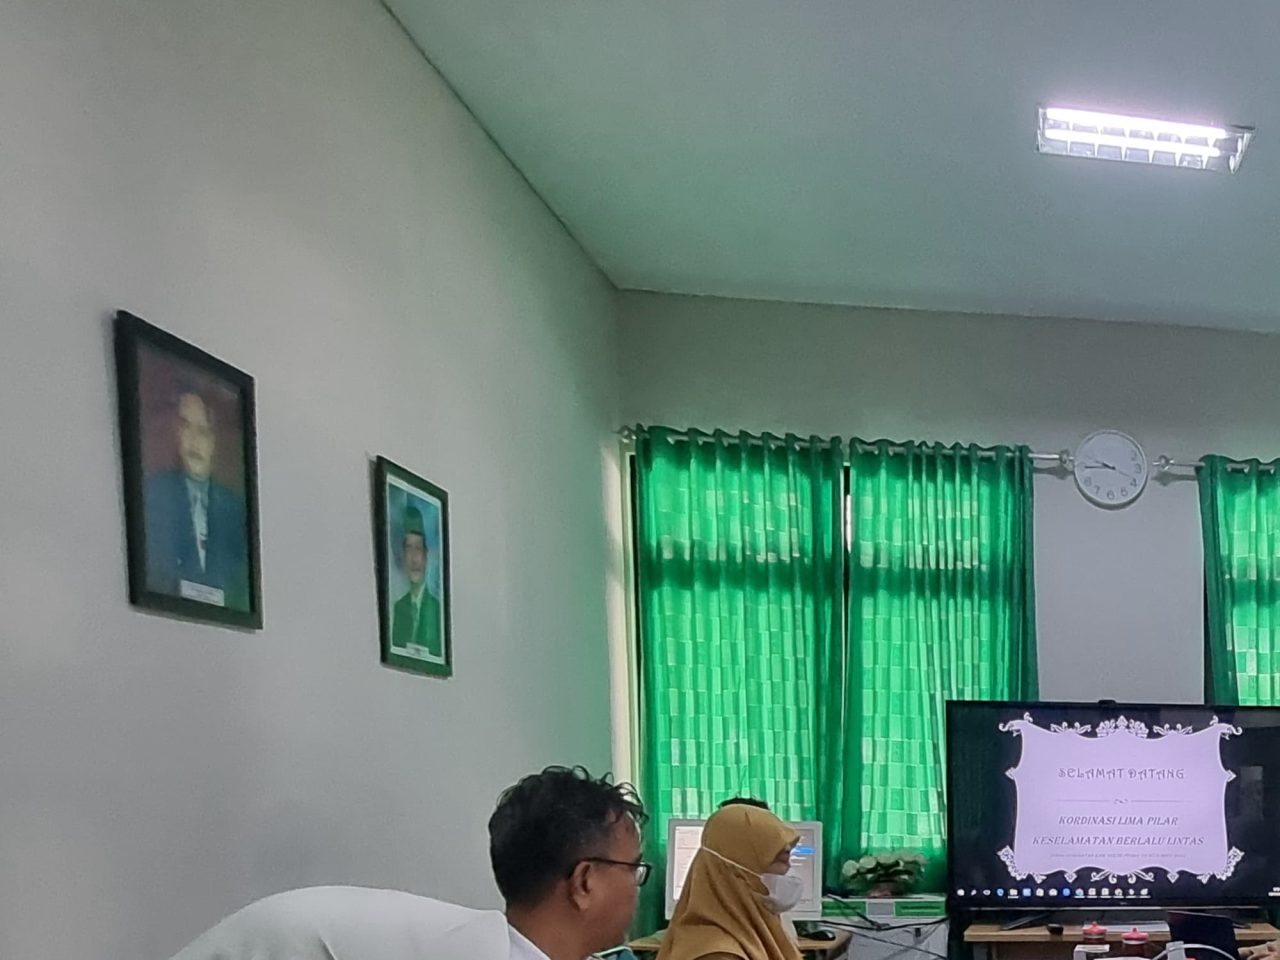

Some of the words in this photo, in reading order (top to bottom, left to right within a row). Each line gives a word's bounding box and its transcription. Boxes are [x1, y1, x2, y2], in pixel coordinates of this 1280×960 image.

[1058, 767, 1124, 780] SELAMAT
[1127, 768, 1185, 781] DATANG
[1058, 815, 1116, 826] KORDINASI
[1117, 816, 1144, 826] LIMA
[1146, 816, 1179, 826] PILAR
[1032, 836, 1116, 846] KESELAMATAN
[1116, 836, 1166, 846] BERLALU
[1167, 836, 1204, 846] LINTAS
